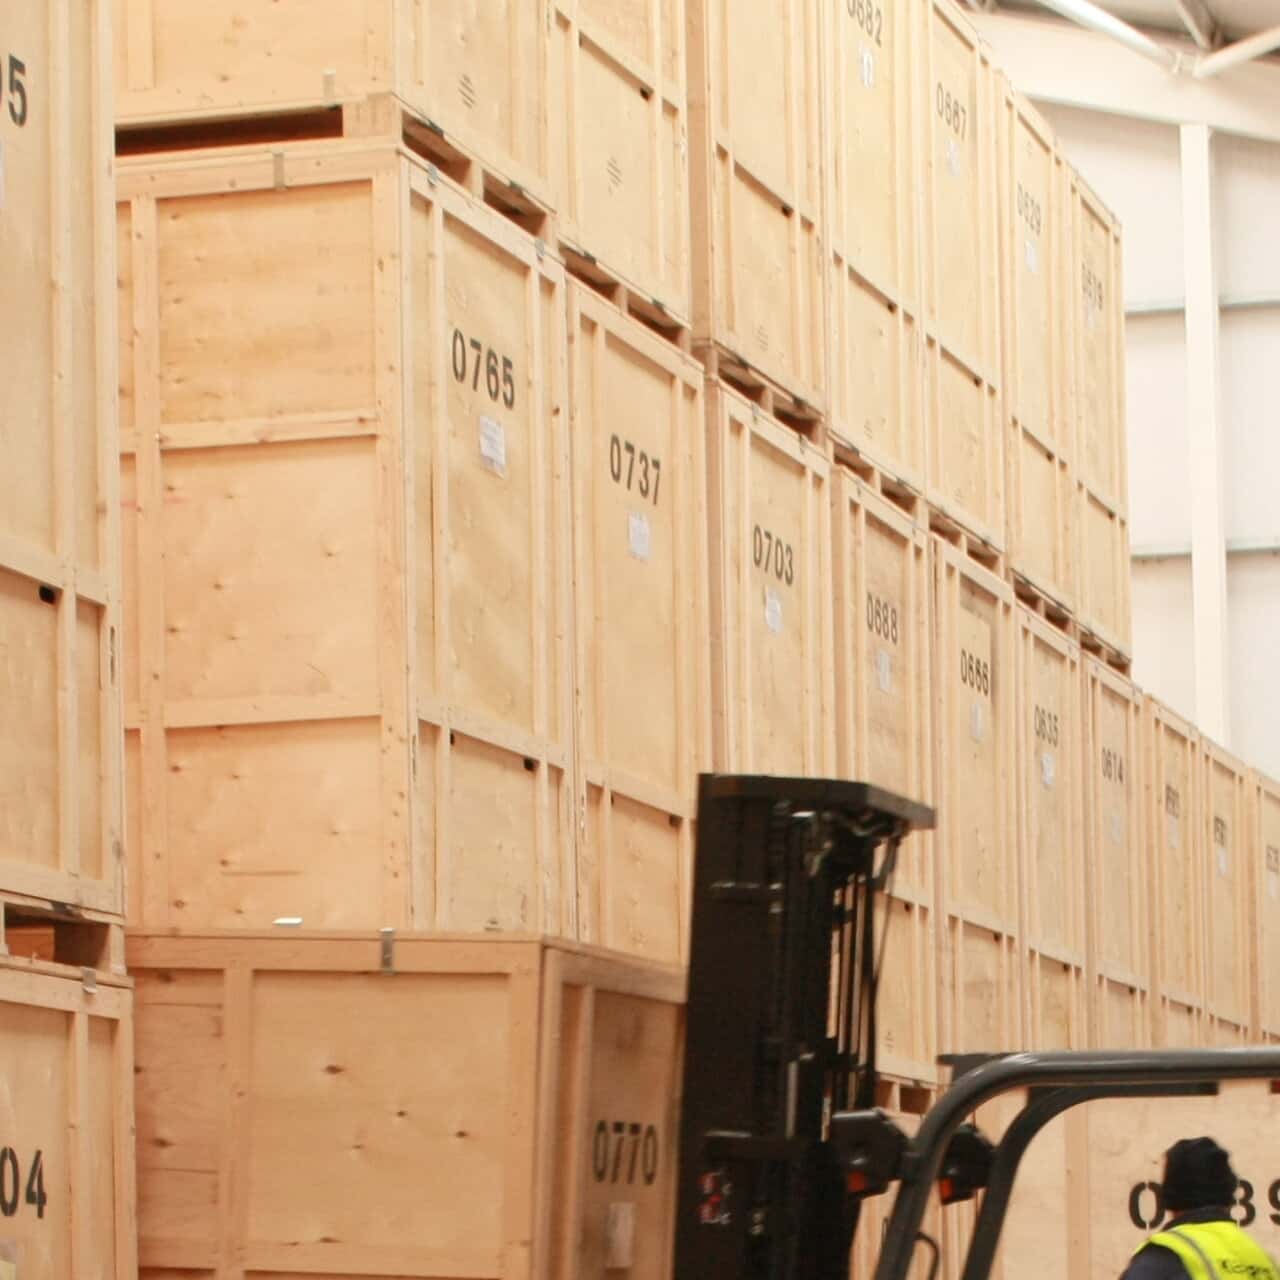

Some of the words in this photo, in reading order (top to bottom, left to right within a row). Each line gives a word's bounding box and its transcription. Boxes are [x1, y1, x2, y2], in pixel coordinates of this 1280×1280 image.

[452, 328, 514, 410] 0765
[610, 434, 660, 505] 0737
[753, 524, 793, 586] 0703
[867, 592, 898, 645] 0688
[593, 1120, 658, 1186] 0770
